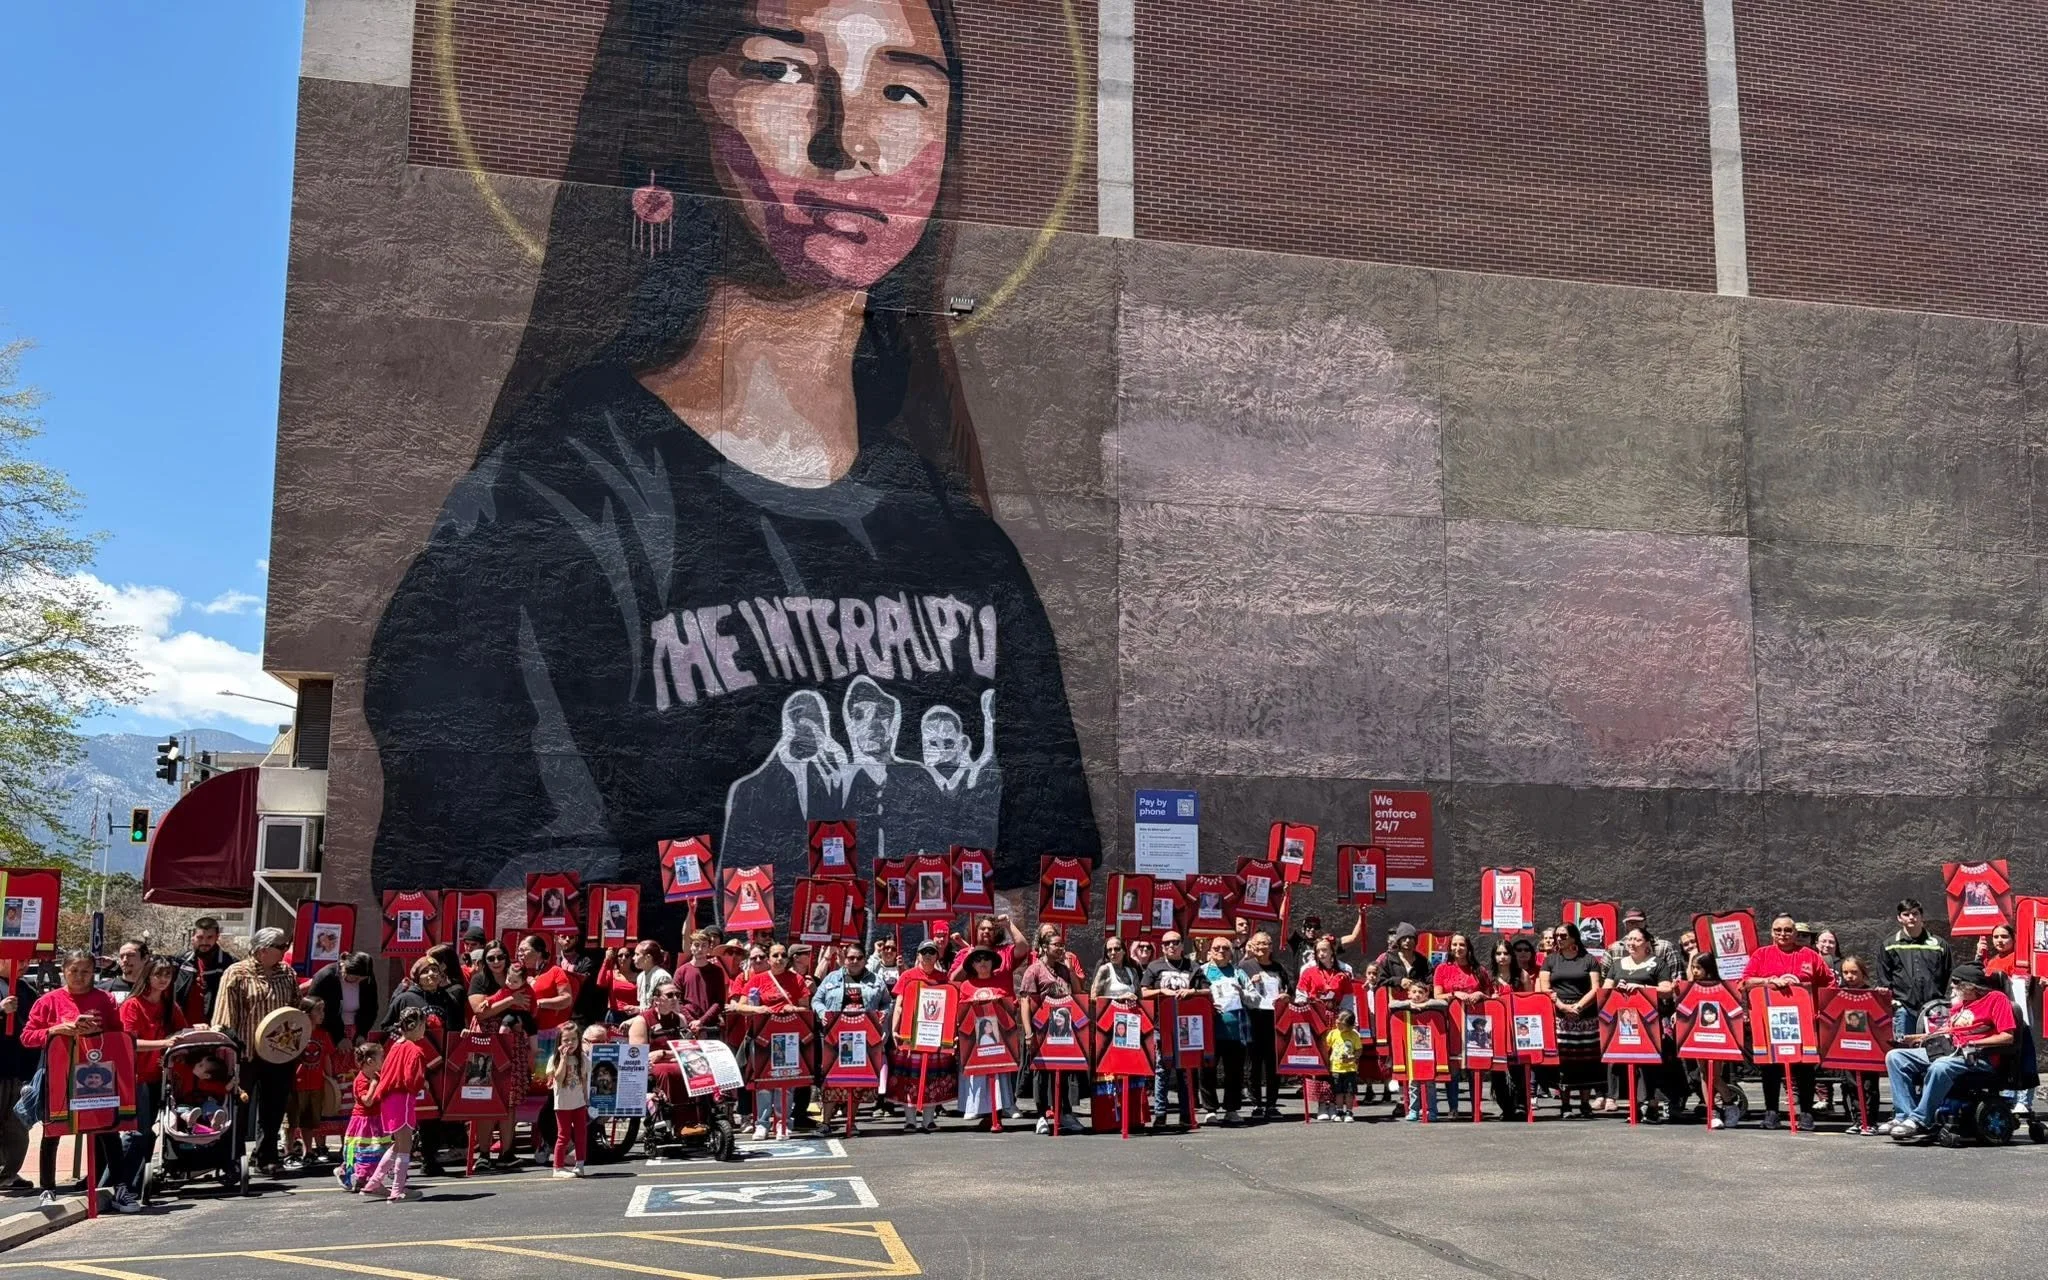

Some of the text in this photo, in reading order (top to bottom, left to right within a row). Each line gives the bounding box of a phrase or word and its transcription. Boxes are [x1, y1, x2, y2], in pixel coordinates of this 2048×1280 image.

[1140, 798, 1167, 808] Pay by
[1374, 795, 1393, 806] We
[1140, 808, 1166, 816] phone
[1375, 808, 1417, 819] enforce
[1375, 820, 1400, 834] 24/7
